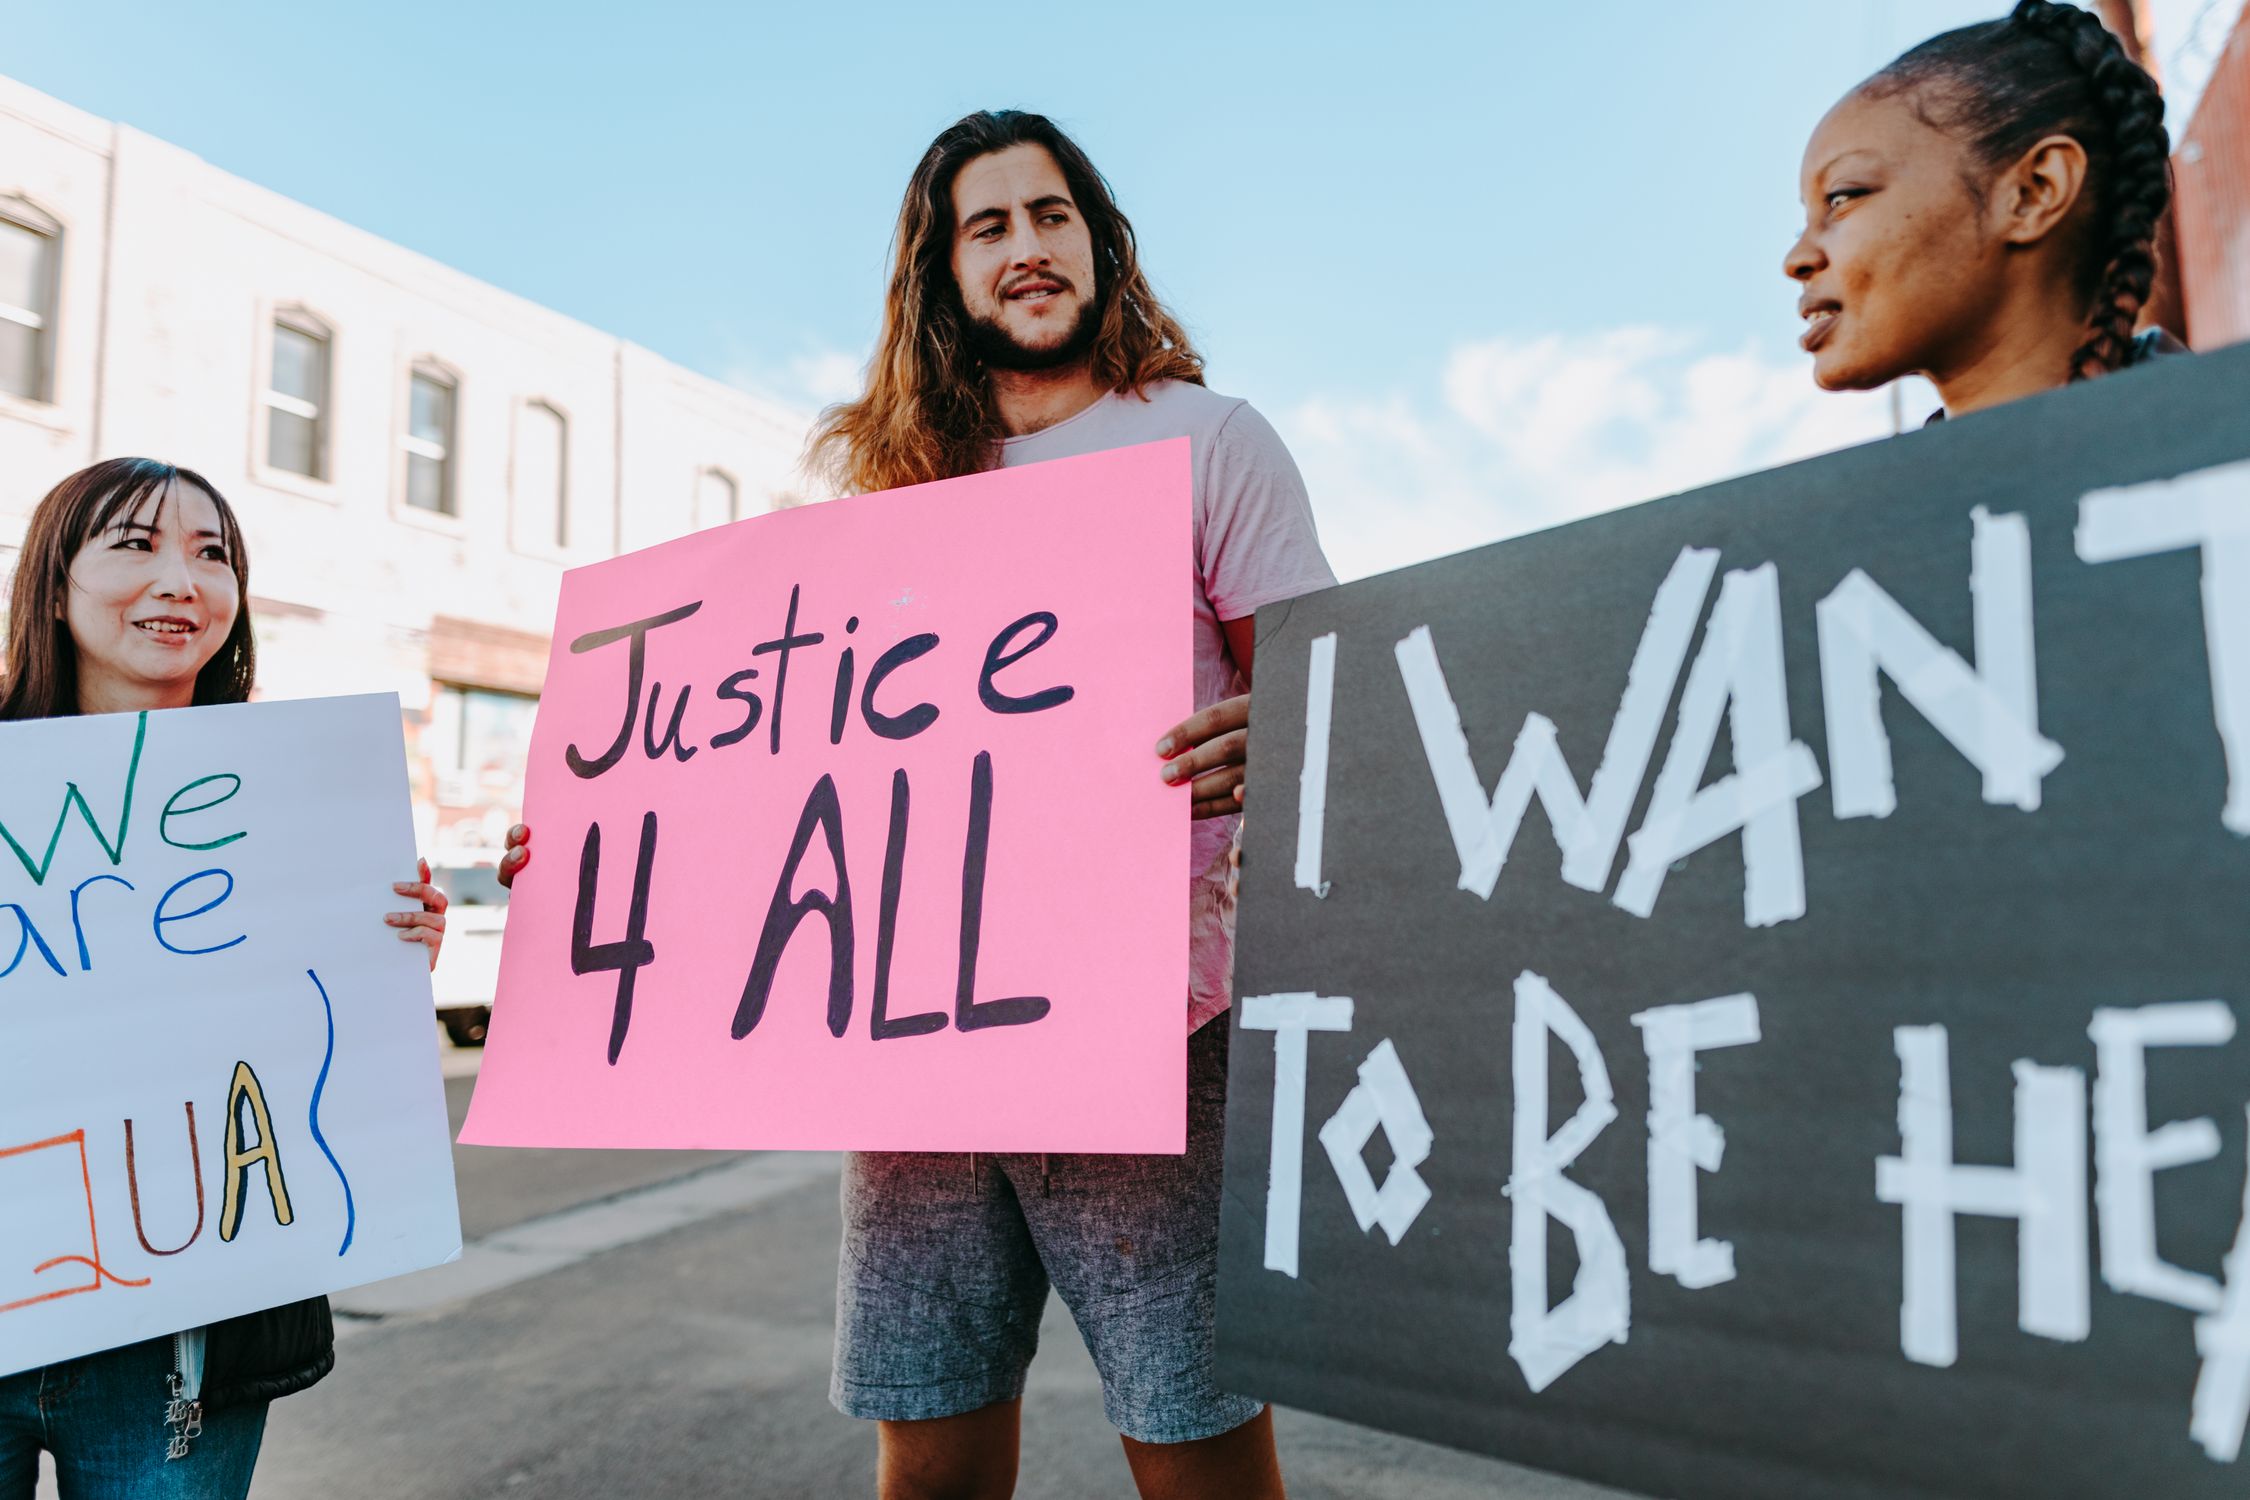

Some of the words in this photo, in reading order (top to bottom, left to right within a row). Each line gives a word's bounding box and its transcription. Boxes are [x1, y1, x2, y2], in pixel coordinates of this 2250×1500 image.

[0, 711, 248, 886] We
[565, 583, 1075, 779] Justice
[1293, 631, 1337, 898] I
[570, 810, 658, 1066] 4
[730, 750, 1052, 1041] ALL
[1240, 991, 1436, 1279] TO
[1501, 968, 1762, 1393] BE
